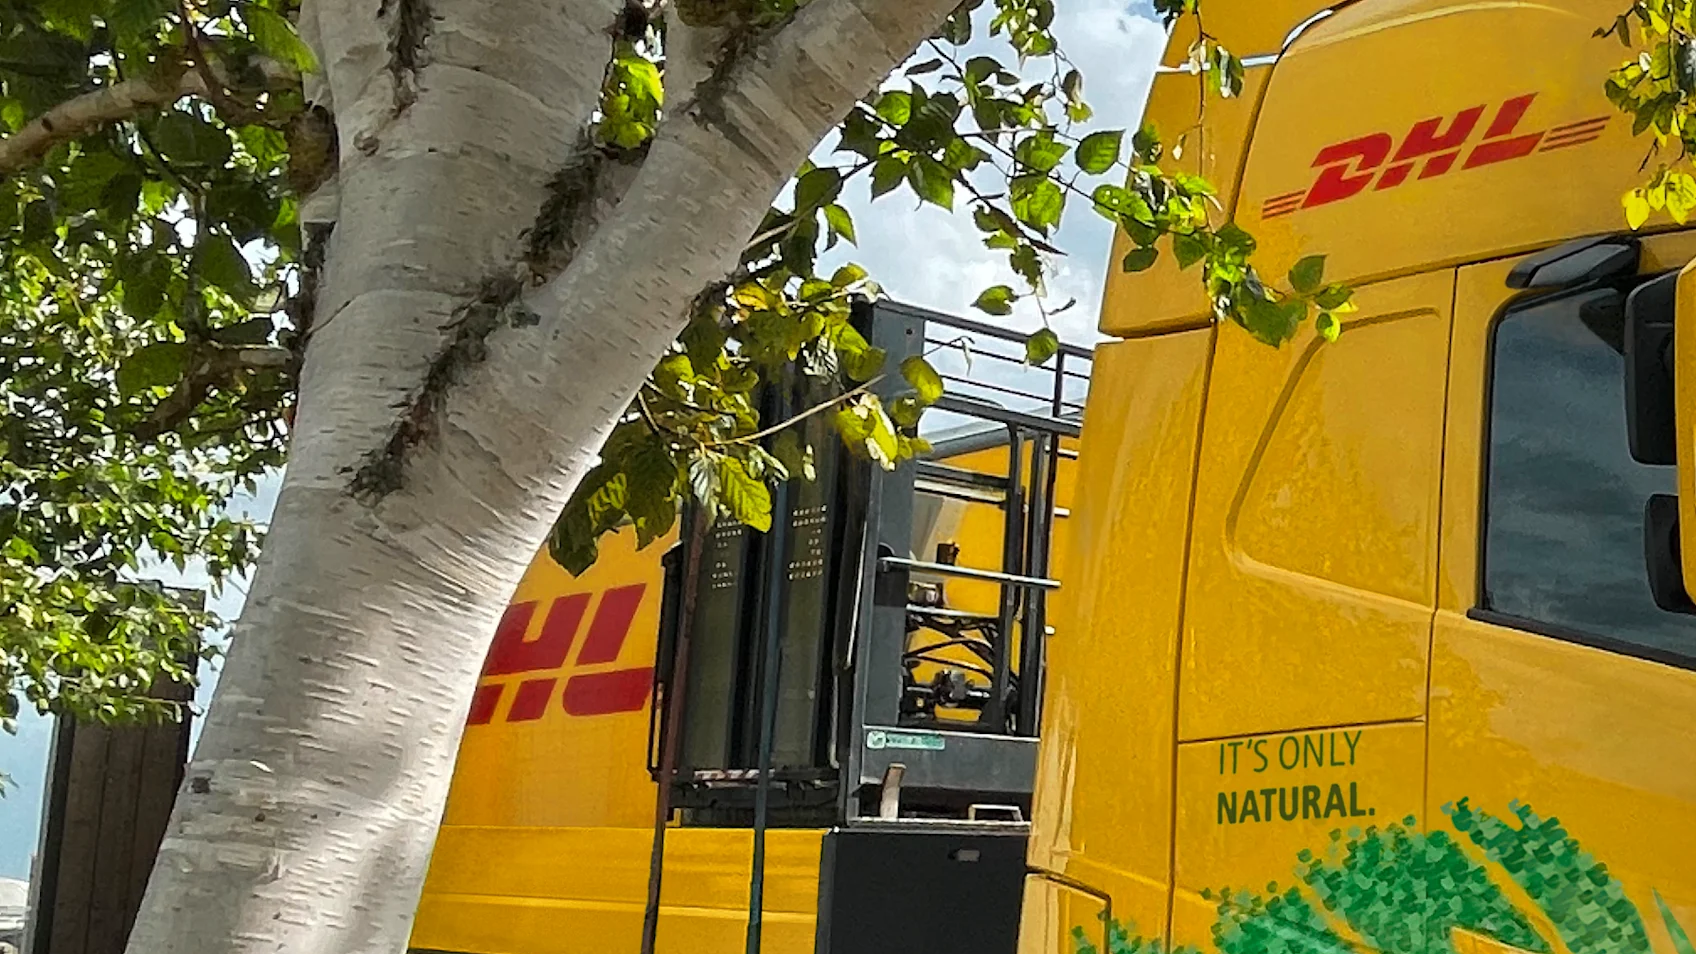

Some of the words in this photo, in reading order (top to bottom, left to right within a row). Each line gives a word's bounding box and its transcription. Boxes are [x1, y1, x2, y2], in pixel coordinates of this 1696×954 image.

[1302, 92, 1545, 209] DHL
[467, 583, 654, 725] HL
[1220, 738, 1269, 775] IT'S
[1279, 730, 1362, 770] ONLY
[1217, 781, 1376, 825] NATURAL.
